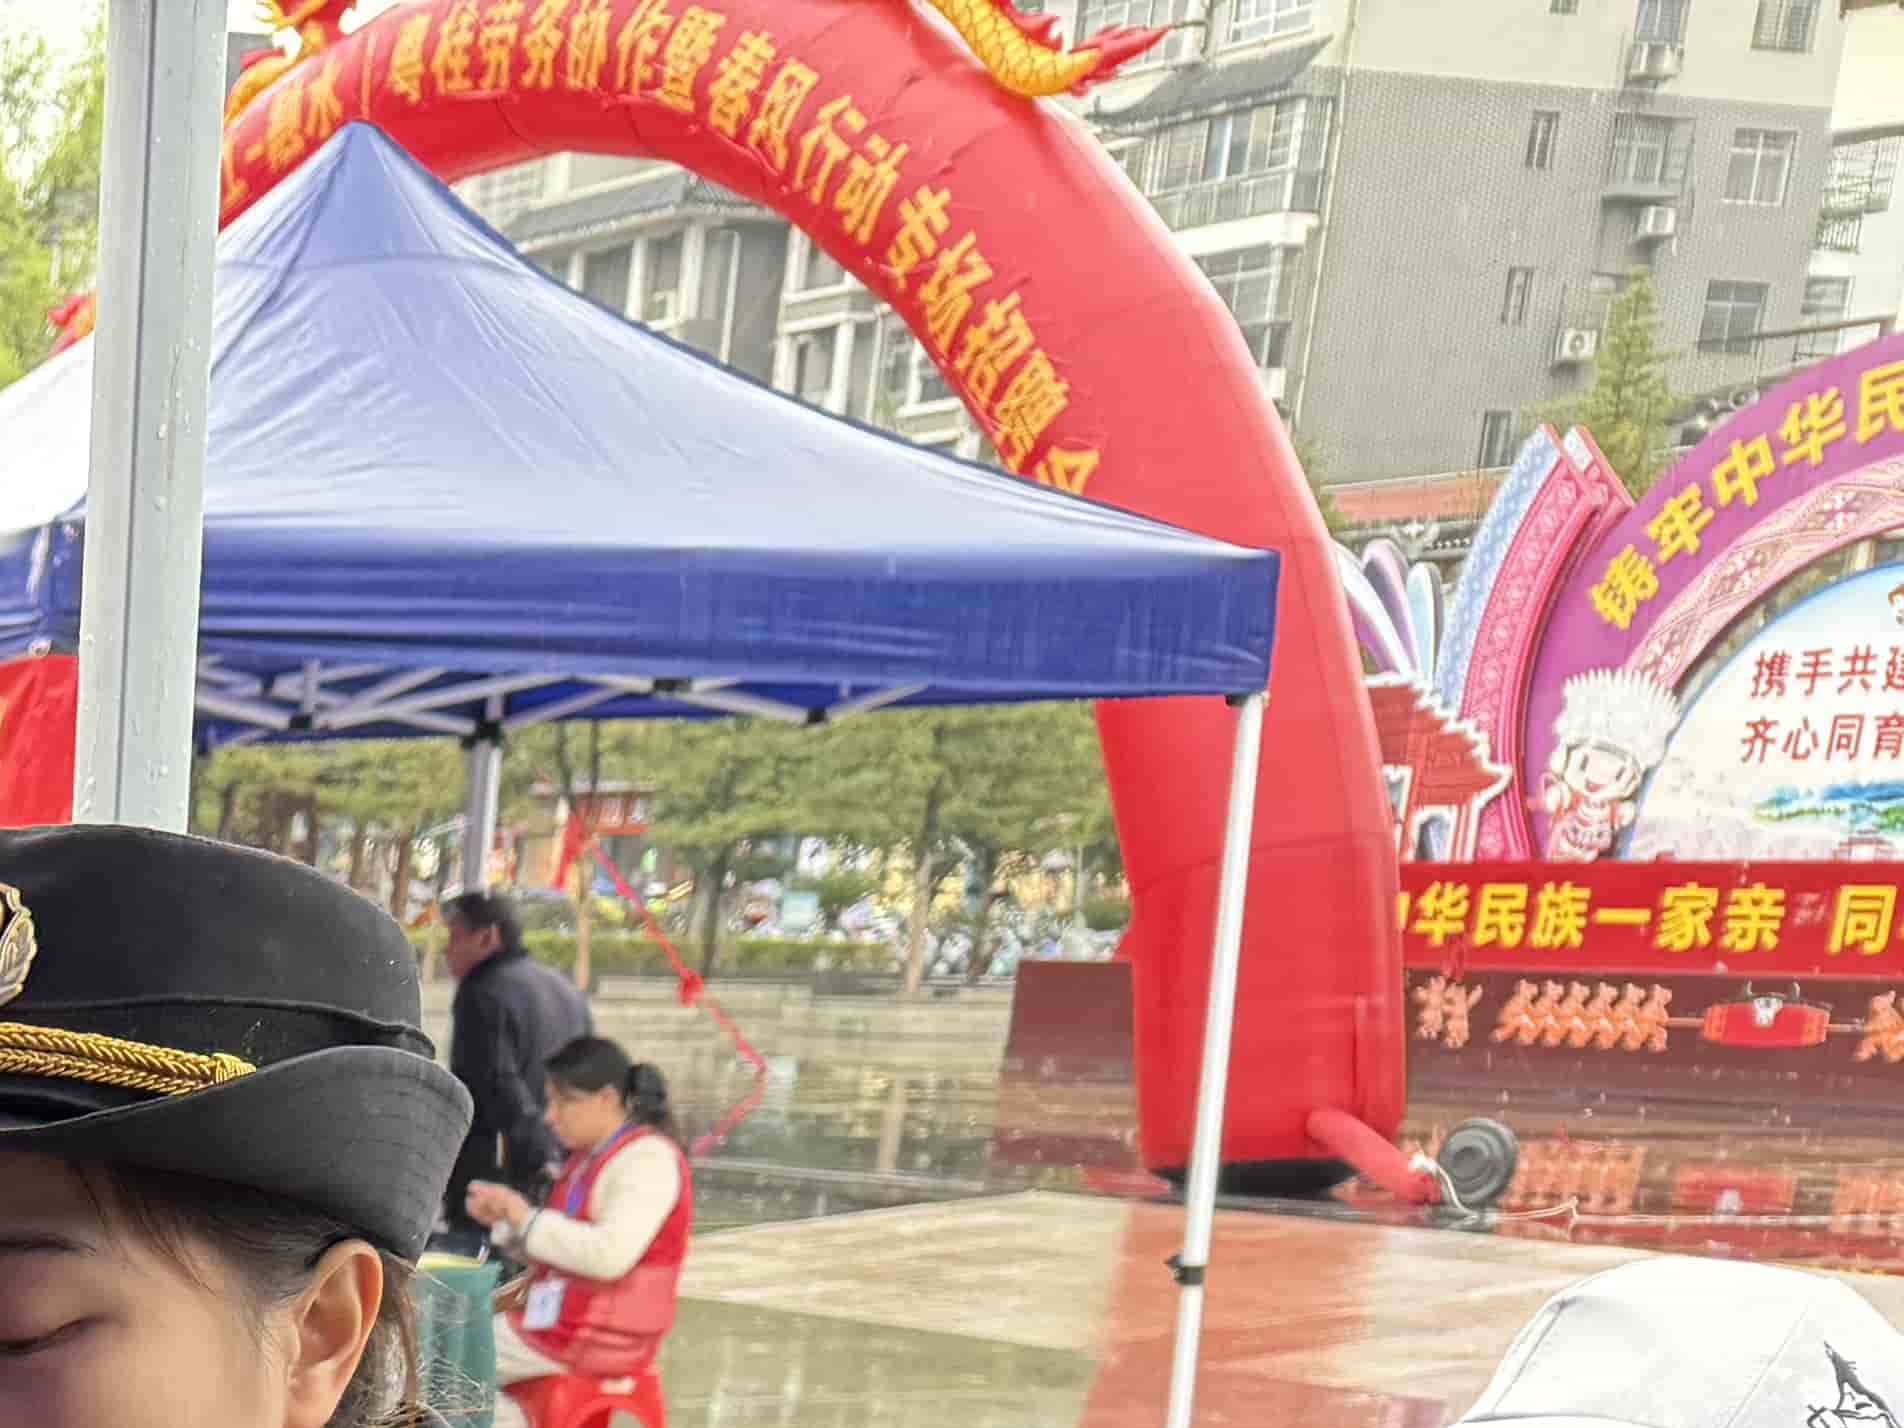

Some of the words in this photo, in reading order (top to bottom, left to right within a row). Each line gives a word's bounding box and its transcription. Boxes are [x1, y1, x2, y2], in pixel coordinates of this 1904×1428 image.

[1397, 881, 1785, 952] 华民族一家亲
